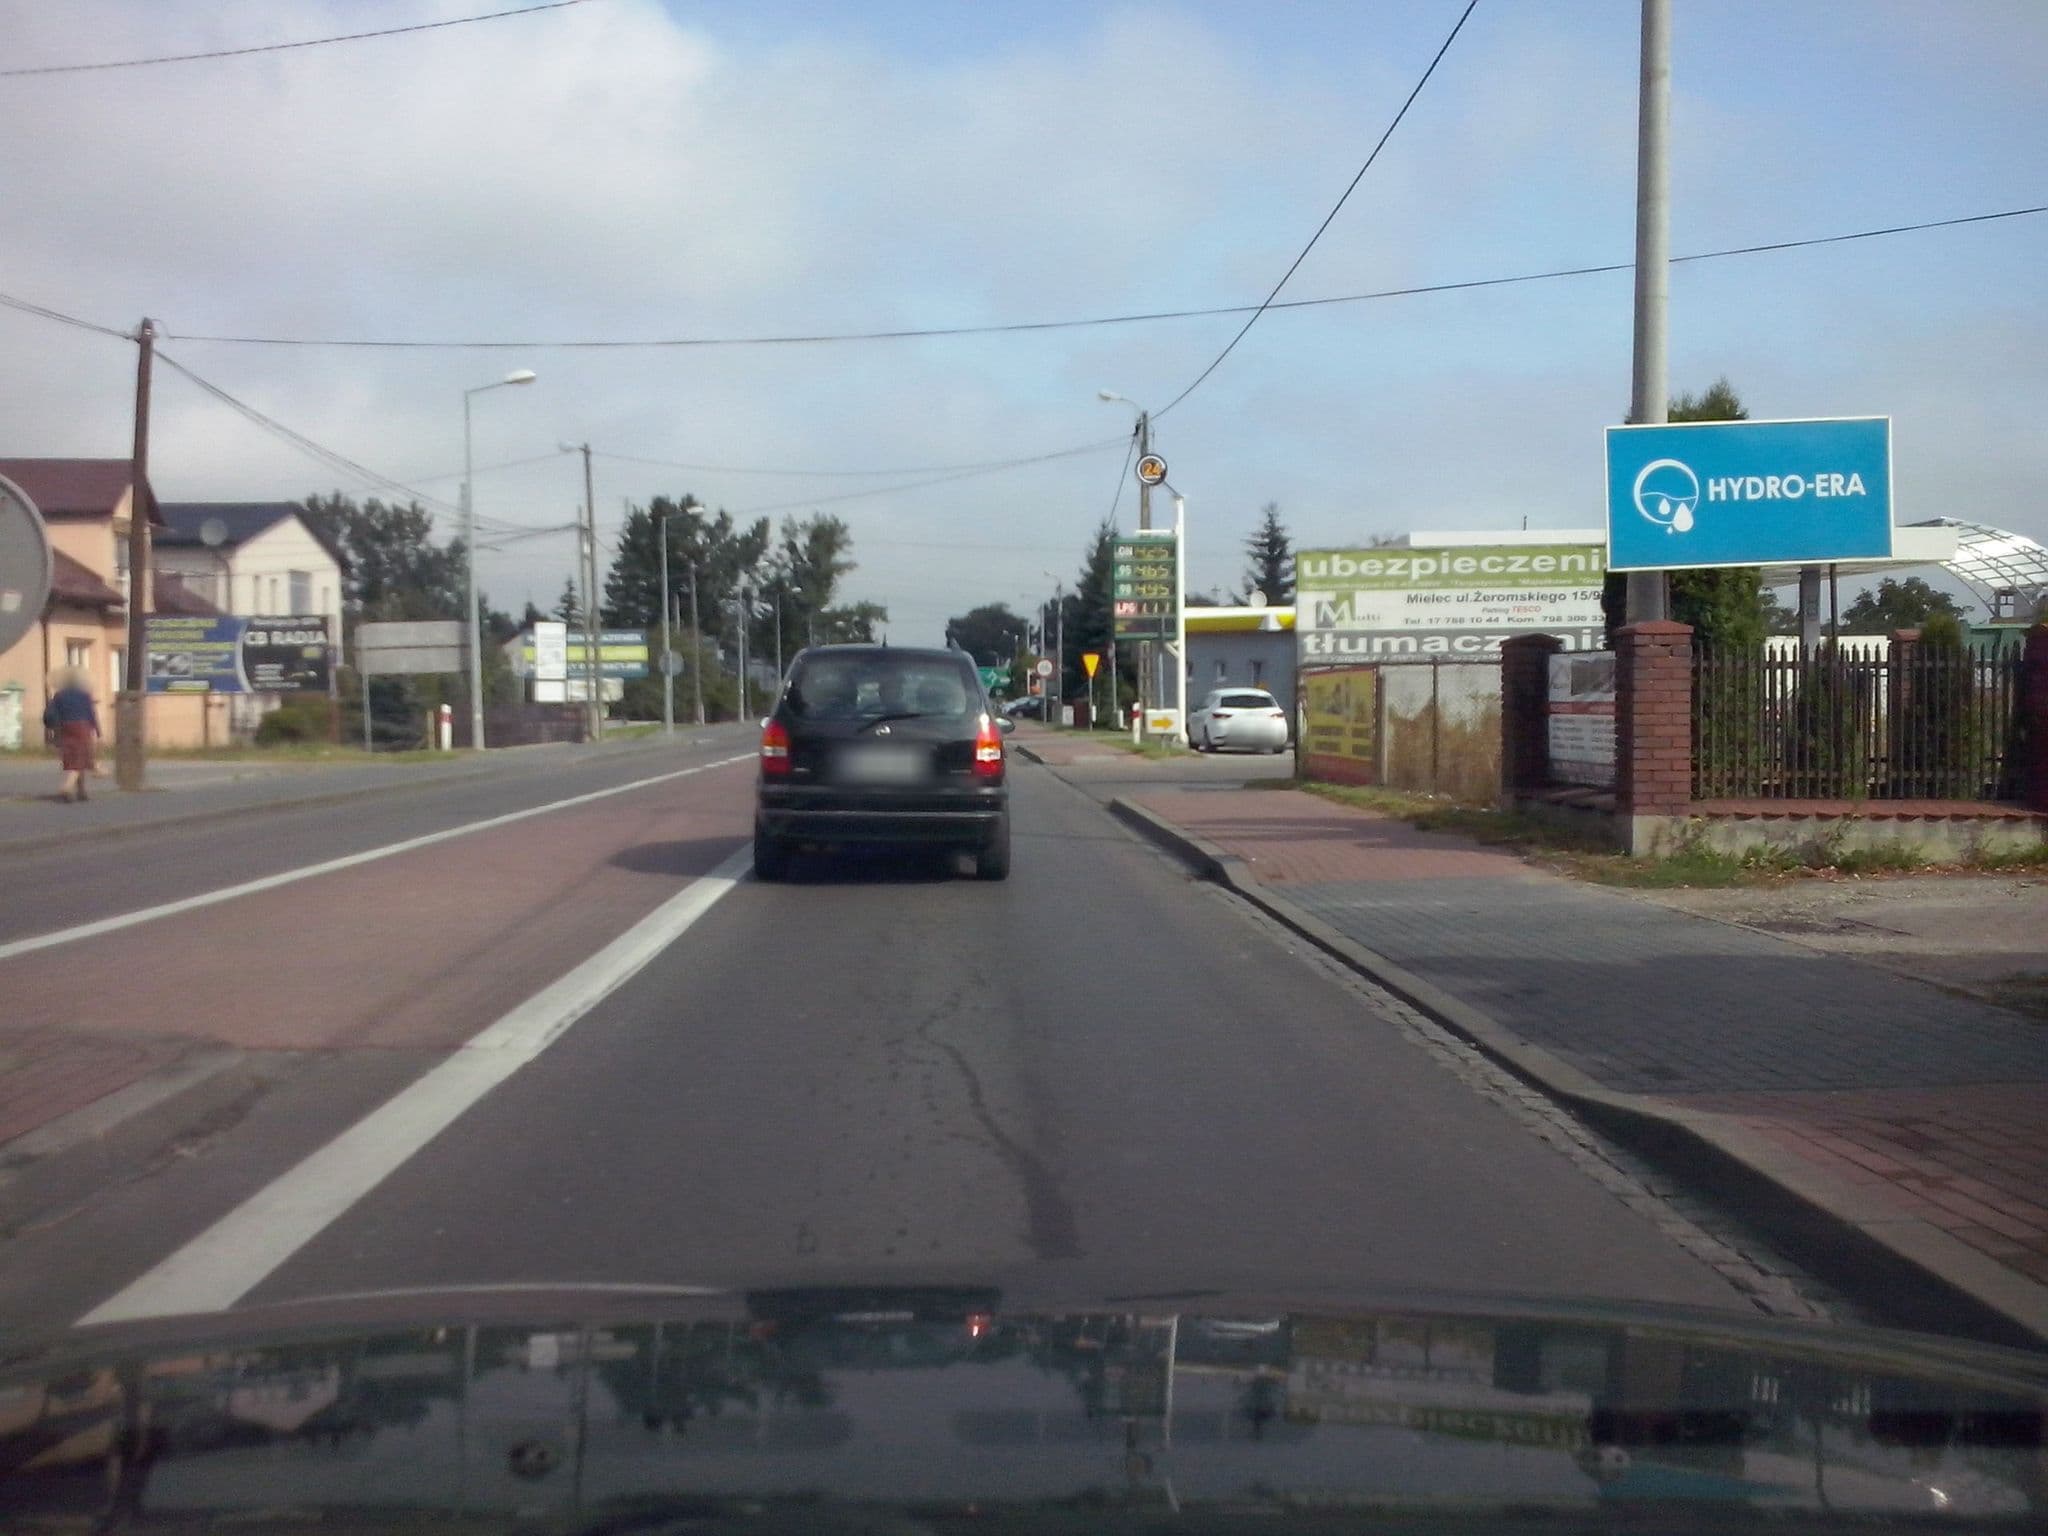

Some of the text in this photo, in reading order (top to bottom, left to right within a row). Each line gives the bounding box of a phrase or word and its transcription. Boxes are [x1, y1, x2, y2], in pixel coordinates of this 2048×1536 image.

[1707, 472, 1867, 502] HYDRO-ERA
[1406, 593, 1451, 604] Mielec
[1573, 590, 1604, 602] 15/9
[1512, 605, 1542, 613] TESCO
[1303, 630, 1606, 653] tłumaczni
